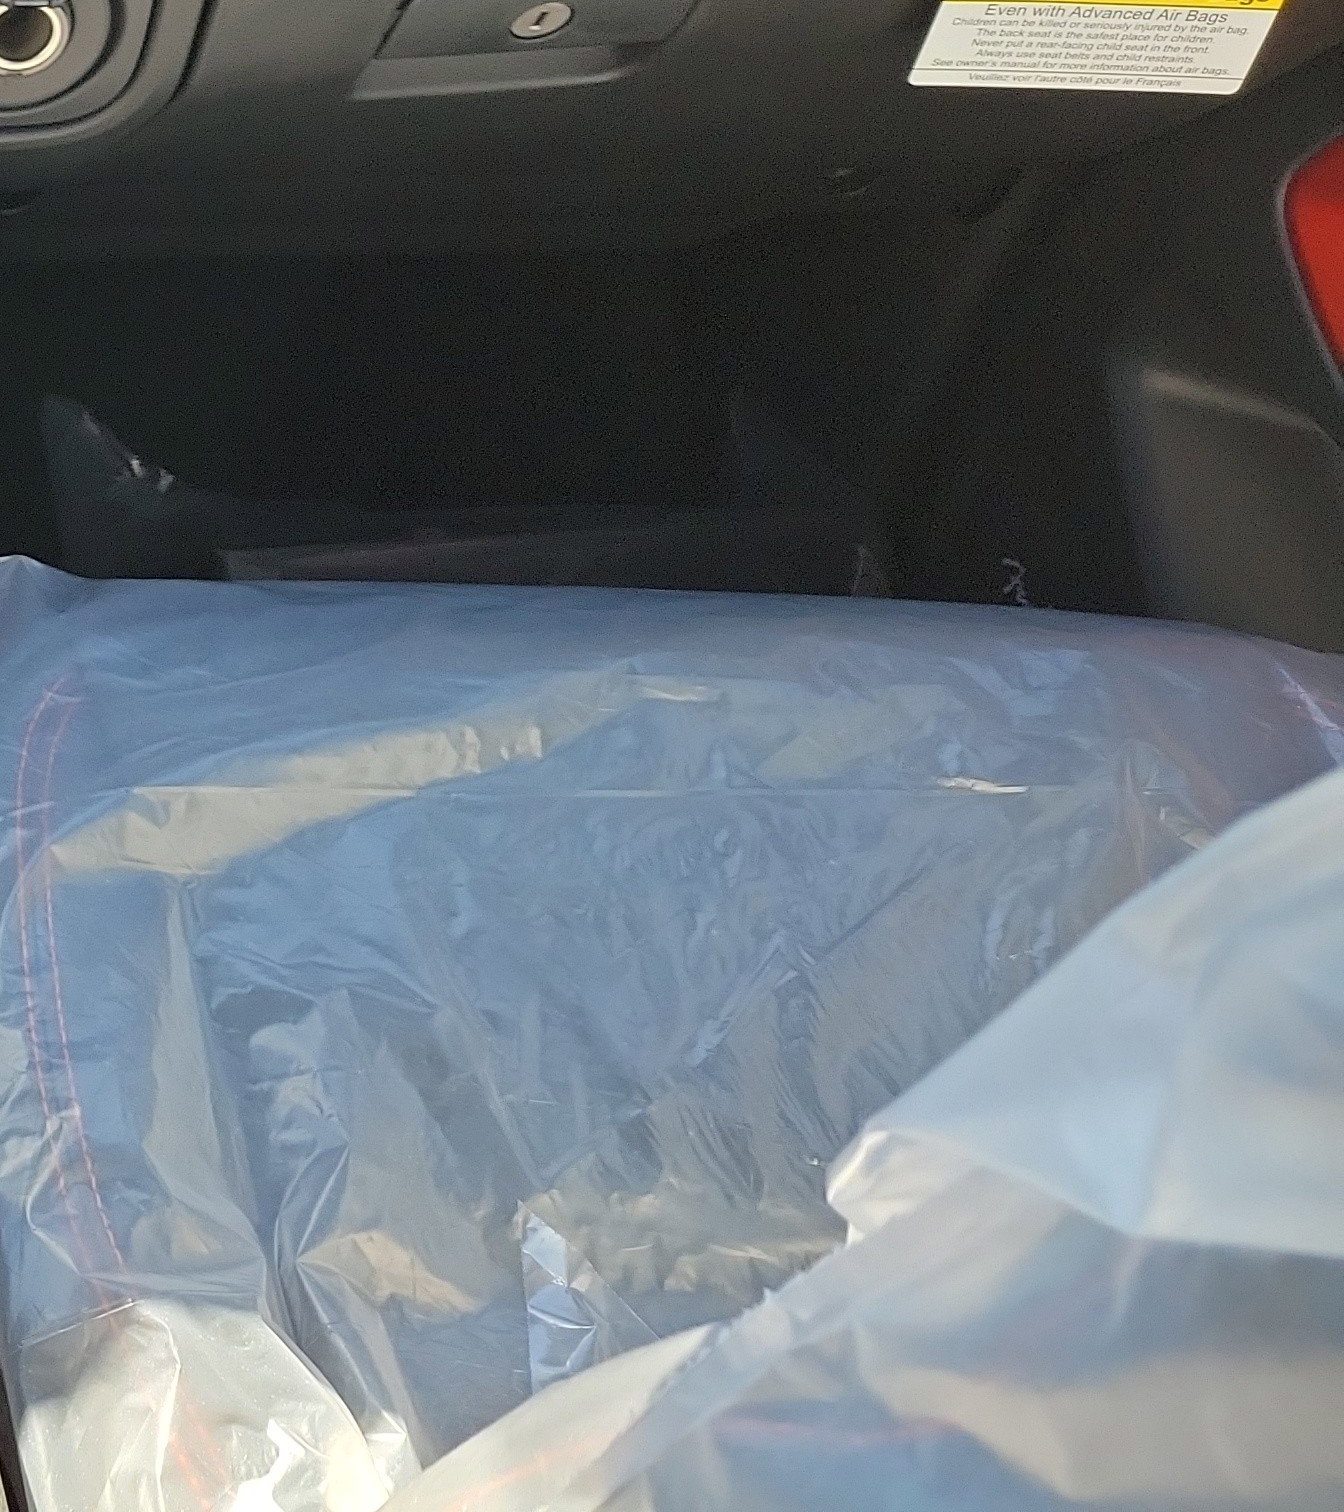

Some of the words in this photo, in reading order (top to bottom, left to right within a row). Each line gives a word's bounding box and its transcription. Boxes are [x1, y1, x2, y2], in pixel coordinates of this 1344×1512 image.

[985, 3, 1026, 16] Even
[1032, 4, 1065, 18] with
[1069, 6, 1155, 20] Advanced
[1156, 9, 1183, 21] Air
[1185, 10, 1228, 25] Bags
[952, 17, 997, 26] Children
[998, 19, 1019, 27] can
[1021, 18, 1036, 27] be
[1039, 19, 1067, 28] killed
[1174, 24, 1187, 33] by
[1190, 25, 1207, 33] the
[1209, 26, 1224, 34] air
[977, 28, 997, 37] The
[999, 29, 1024, 37] back
[1027, 30, 1050, 38] seat
[1065, 31, 1084, 39] the
[1086, 31, 1118, 40] safest
[1121, 32, 1151, 42] place
[1154, 33, 1168, 41] for
